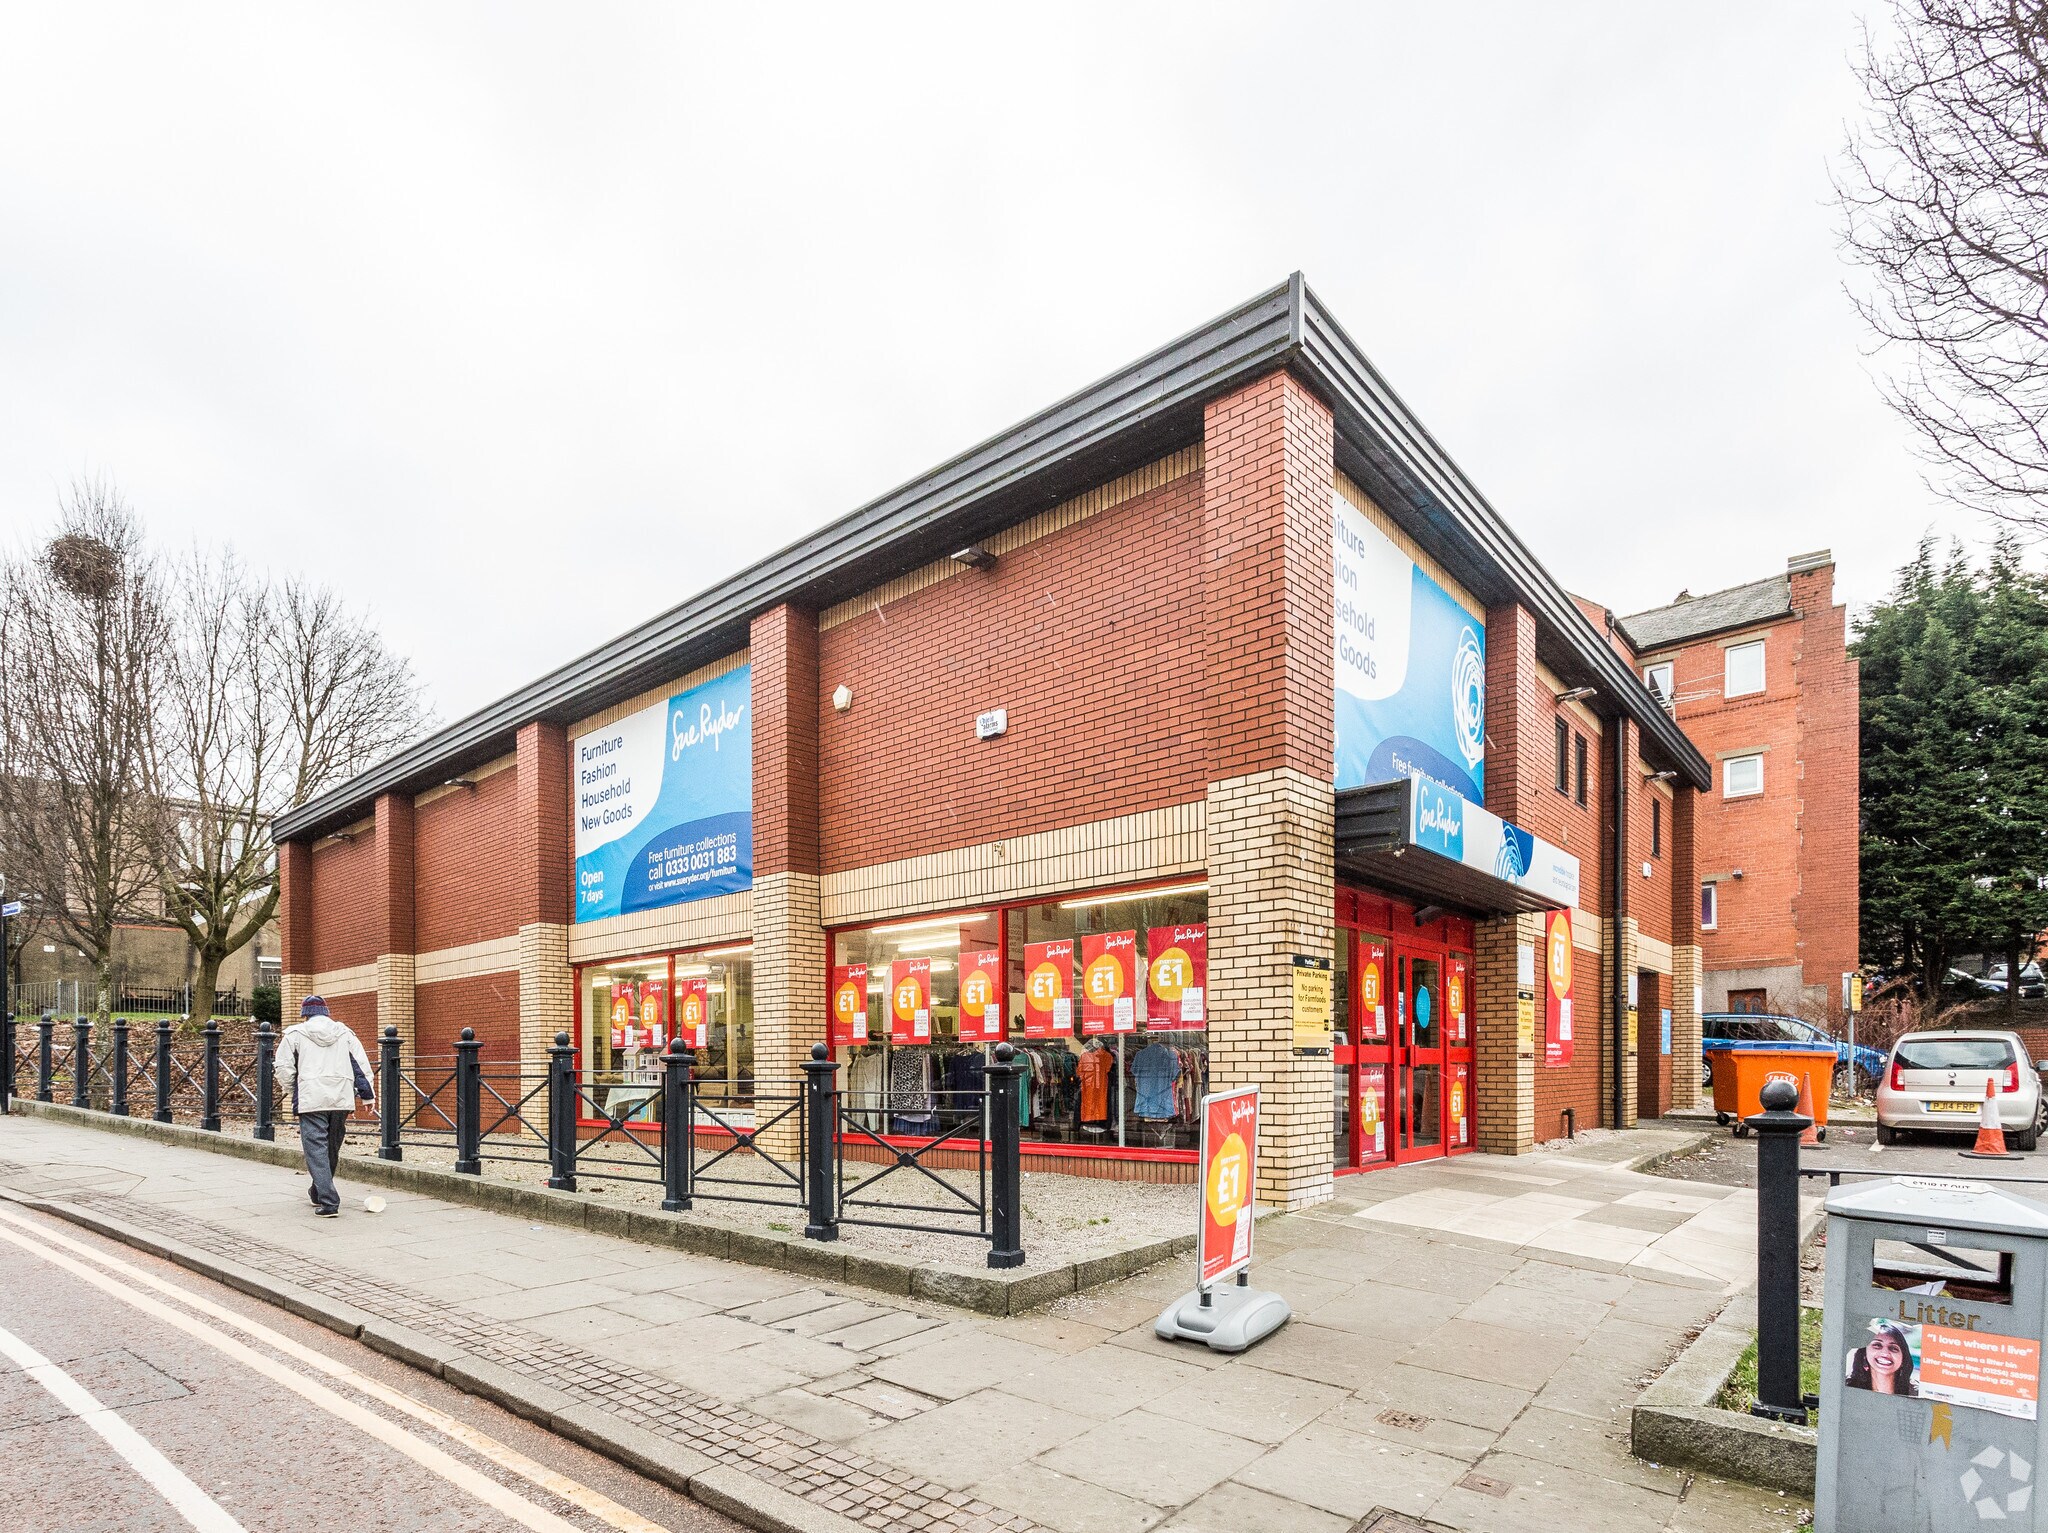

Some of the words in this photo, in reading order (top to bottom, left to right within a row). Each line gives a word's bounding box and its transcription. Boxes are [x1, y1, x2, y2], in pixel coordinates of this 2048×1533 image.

[1335, 598, 1374, 642] sehold
[1340, 634, 1376, 680] Goods
[672, 711, 700, 762] Sue
[699, 700, 744, 752] Ryder
[582, 735, 623, 763] Furniture
[1392, 752, 1407, 774] Free
[582, 762, 616, 786] Fashion
[582, 778, 631, 808] Household
[582, 813, 601, 832] New
[603, 803, 632, 825] Goods
[1420, 786, 1438, 833] Sue
[1436, 797, 1460, 848] Ryder
[649, 852, 663, 864] Free
[664, 844, 694, 860] furniture
[696, 832, 736, 851] collections
[649, 863, 662, 880] call
[666, 857, 689, 876] 0333
[690, 850, 714, 870] 0031
[717, 845, 736, 864] 883
[582, 871, 603, 888] Open
[654, 881, 663, 890] visit
[664, 866, 736, 888] www.sueryder.org/furniture
[581, 891, 586, 903] 7
[587, 890, 603, 903] days
[1106, 936, 1116, 949] Sue
[1116, 936, 1133, 949] Ryder
[1174, 928, 1186, 942] Sue
[1186, 929, 1204, 942] Ryder
[1046, 945, 1056, 958] Sue
[1056, 945, 1071, 958] Ryder
[1092, 971, 1114, 993] £1
[1158, 964, 1182, 987] £1
[1297, 969, 1311, 978] Private
[1313, 972, 1327, 981] Parking
[966, 984, 984, 1003] £1
[1033, 977, 1054, 997] £1
[1308, 984, 1323, 994] parking
[1365, 980, 1376, 998] £1
[1451, 988, 1459, 1002] £1
[839, 994, 854, 1012] £1
[899, 991, 915, 1008] £1
[1305, 995, 1326, 1004] Farmfoods
[616, 1008, 625, 1022] £1
[644, 1005, 654, 1020] £1
[686, 1006, 697, 1020] £1
[1365, 1101, 1376, 1122] £1
[1452, 1096, 1461, 1112] £1
[1217, 1162, 1239, 1204] £1
[1899, 1300, 1981, 1330] Litter
[1939, 1335, 1961, 1346] love
[1963, 1340, 1998, 1352] where
[2001, 1344, 2005, 1352] I
[1940, 1352, 1964, 1360] Please
[1986, 1358, 2004, 1366] litter
[2005, 1360, 2017, 1368] bin
[1942, 1362, 1964, 1370] report
[1966, 1364, 1982, 1372] line:
[1970, 1373, 1998, 1384] littering
